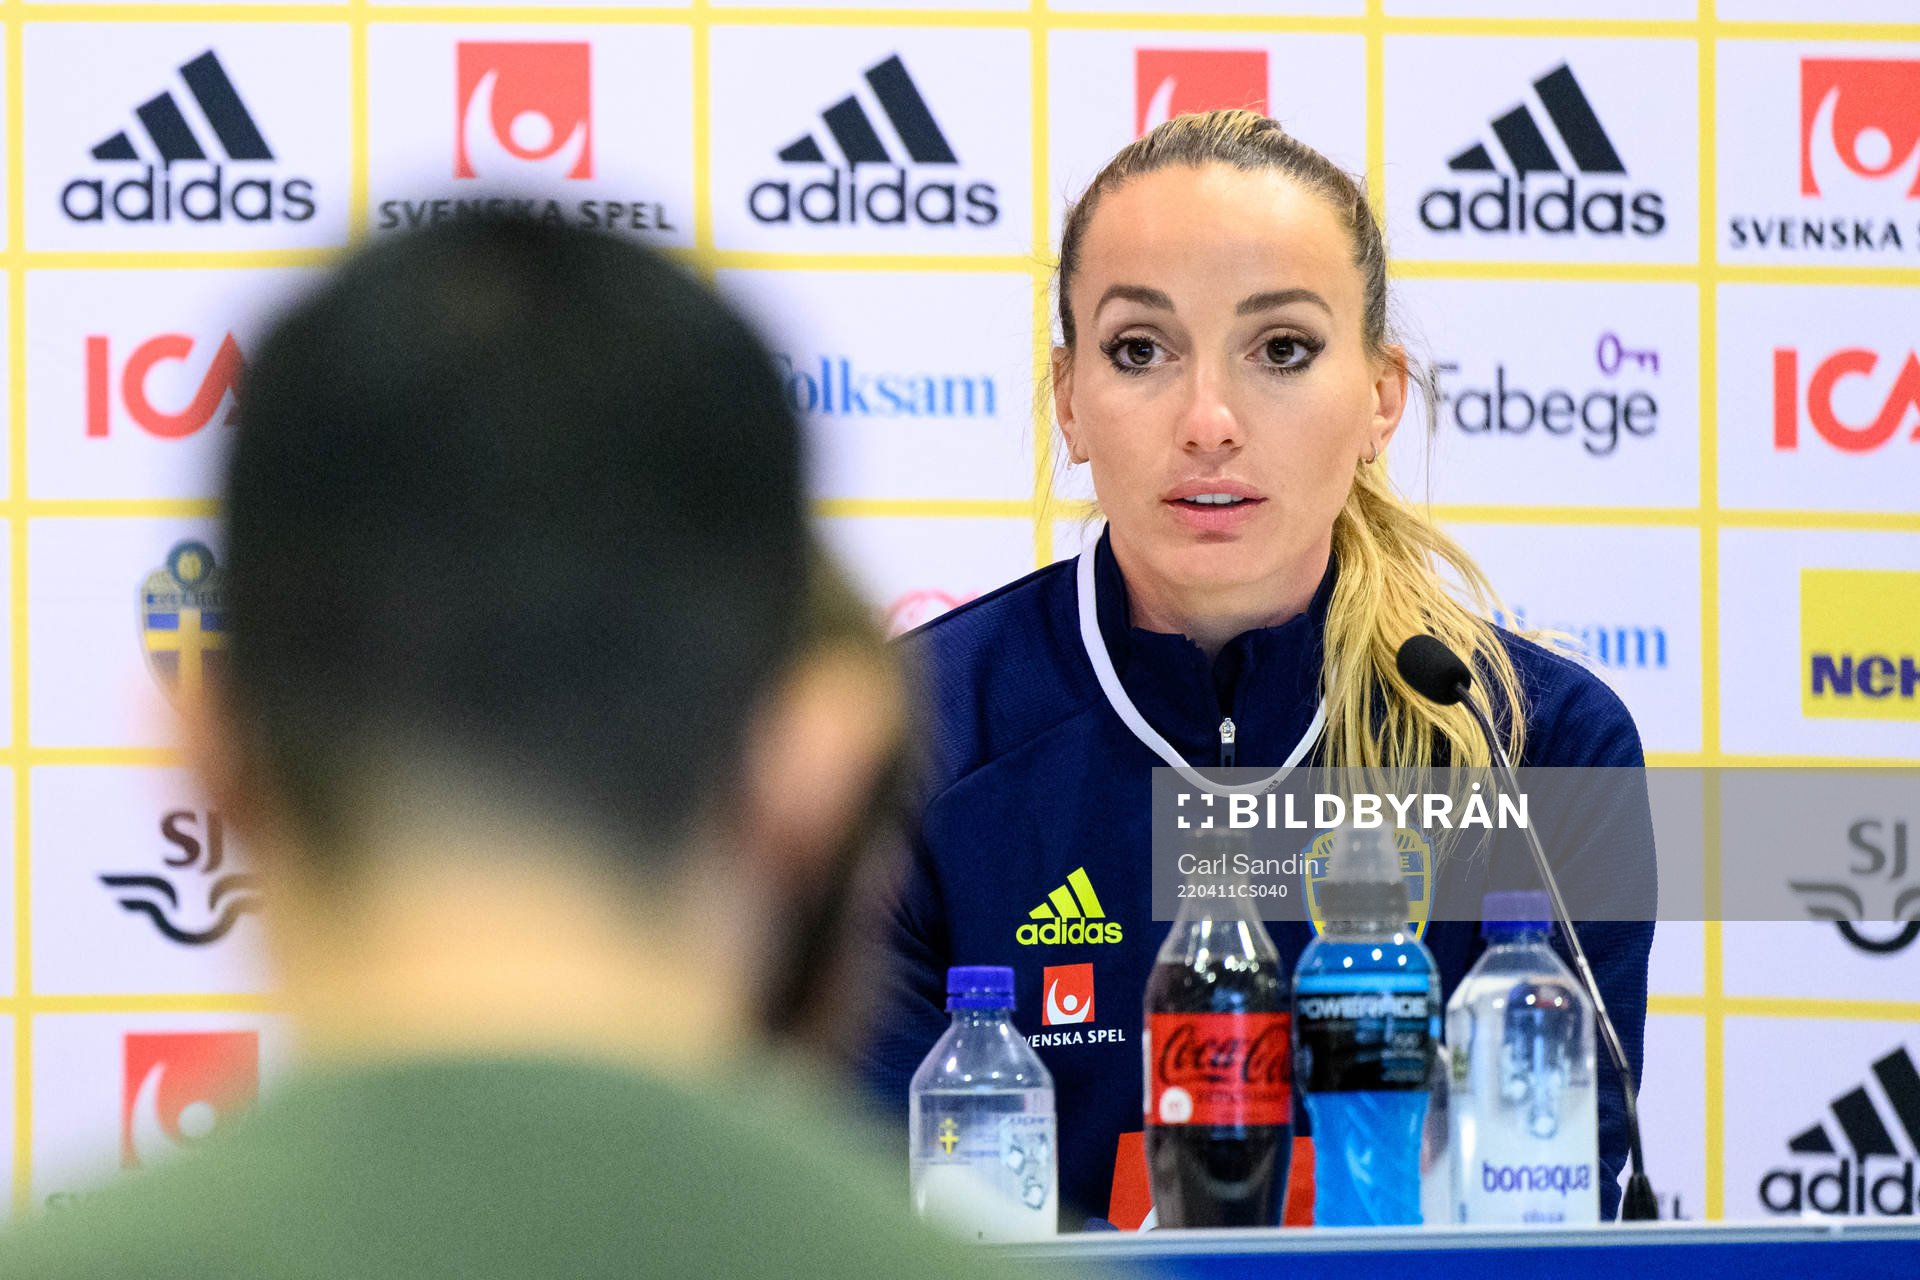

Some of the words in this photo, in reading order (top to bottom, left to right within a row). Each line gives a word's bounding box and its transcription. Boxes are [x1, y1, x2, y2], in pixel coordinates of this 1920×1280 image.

[61, 165, 316, 222] adidas
[580, 200, 676, 231] SPEL
[748, 169, 999, 225] adidas
[1420, 177, 1665, 236] adidas
[1731, 217, 1903, 249] SVENSKA
[161, 811, 224, 872] SJ
[1847, 820, 1908, 880] SJ
[1016, 916, 1123, 945] adidas
[1022, 1031, 1083, 1048] VENSKA
[1087, 1029, 1126, 1043] SPEL
[1483, 1162, 1590, 1196] bonaqua
[1759, 1158, 1920, 1216] adid
